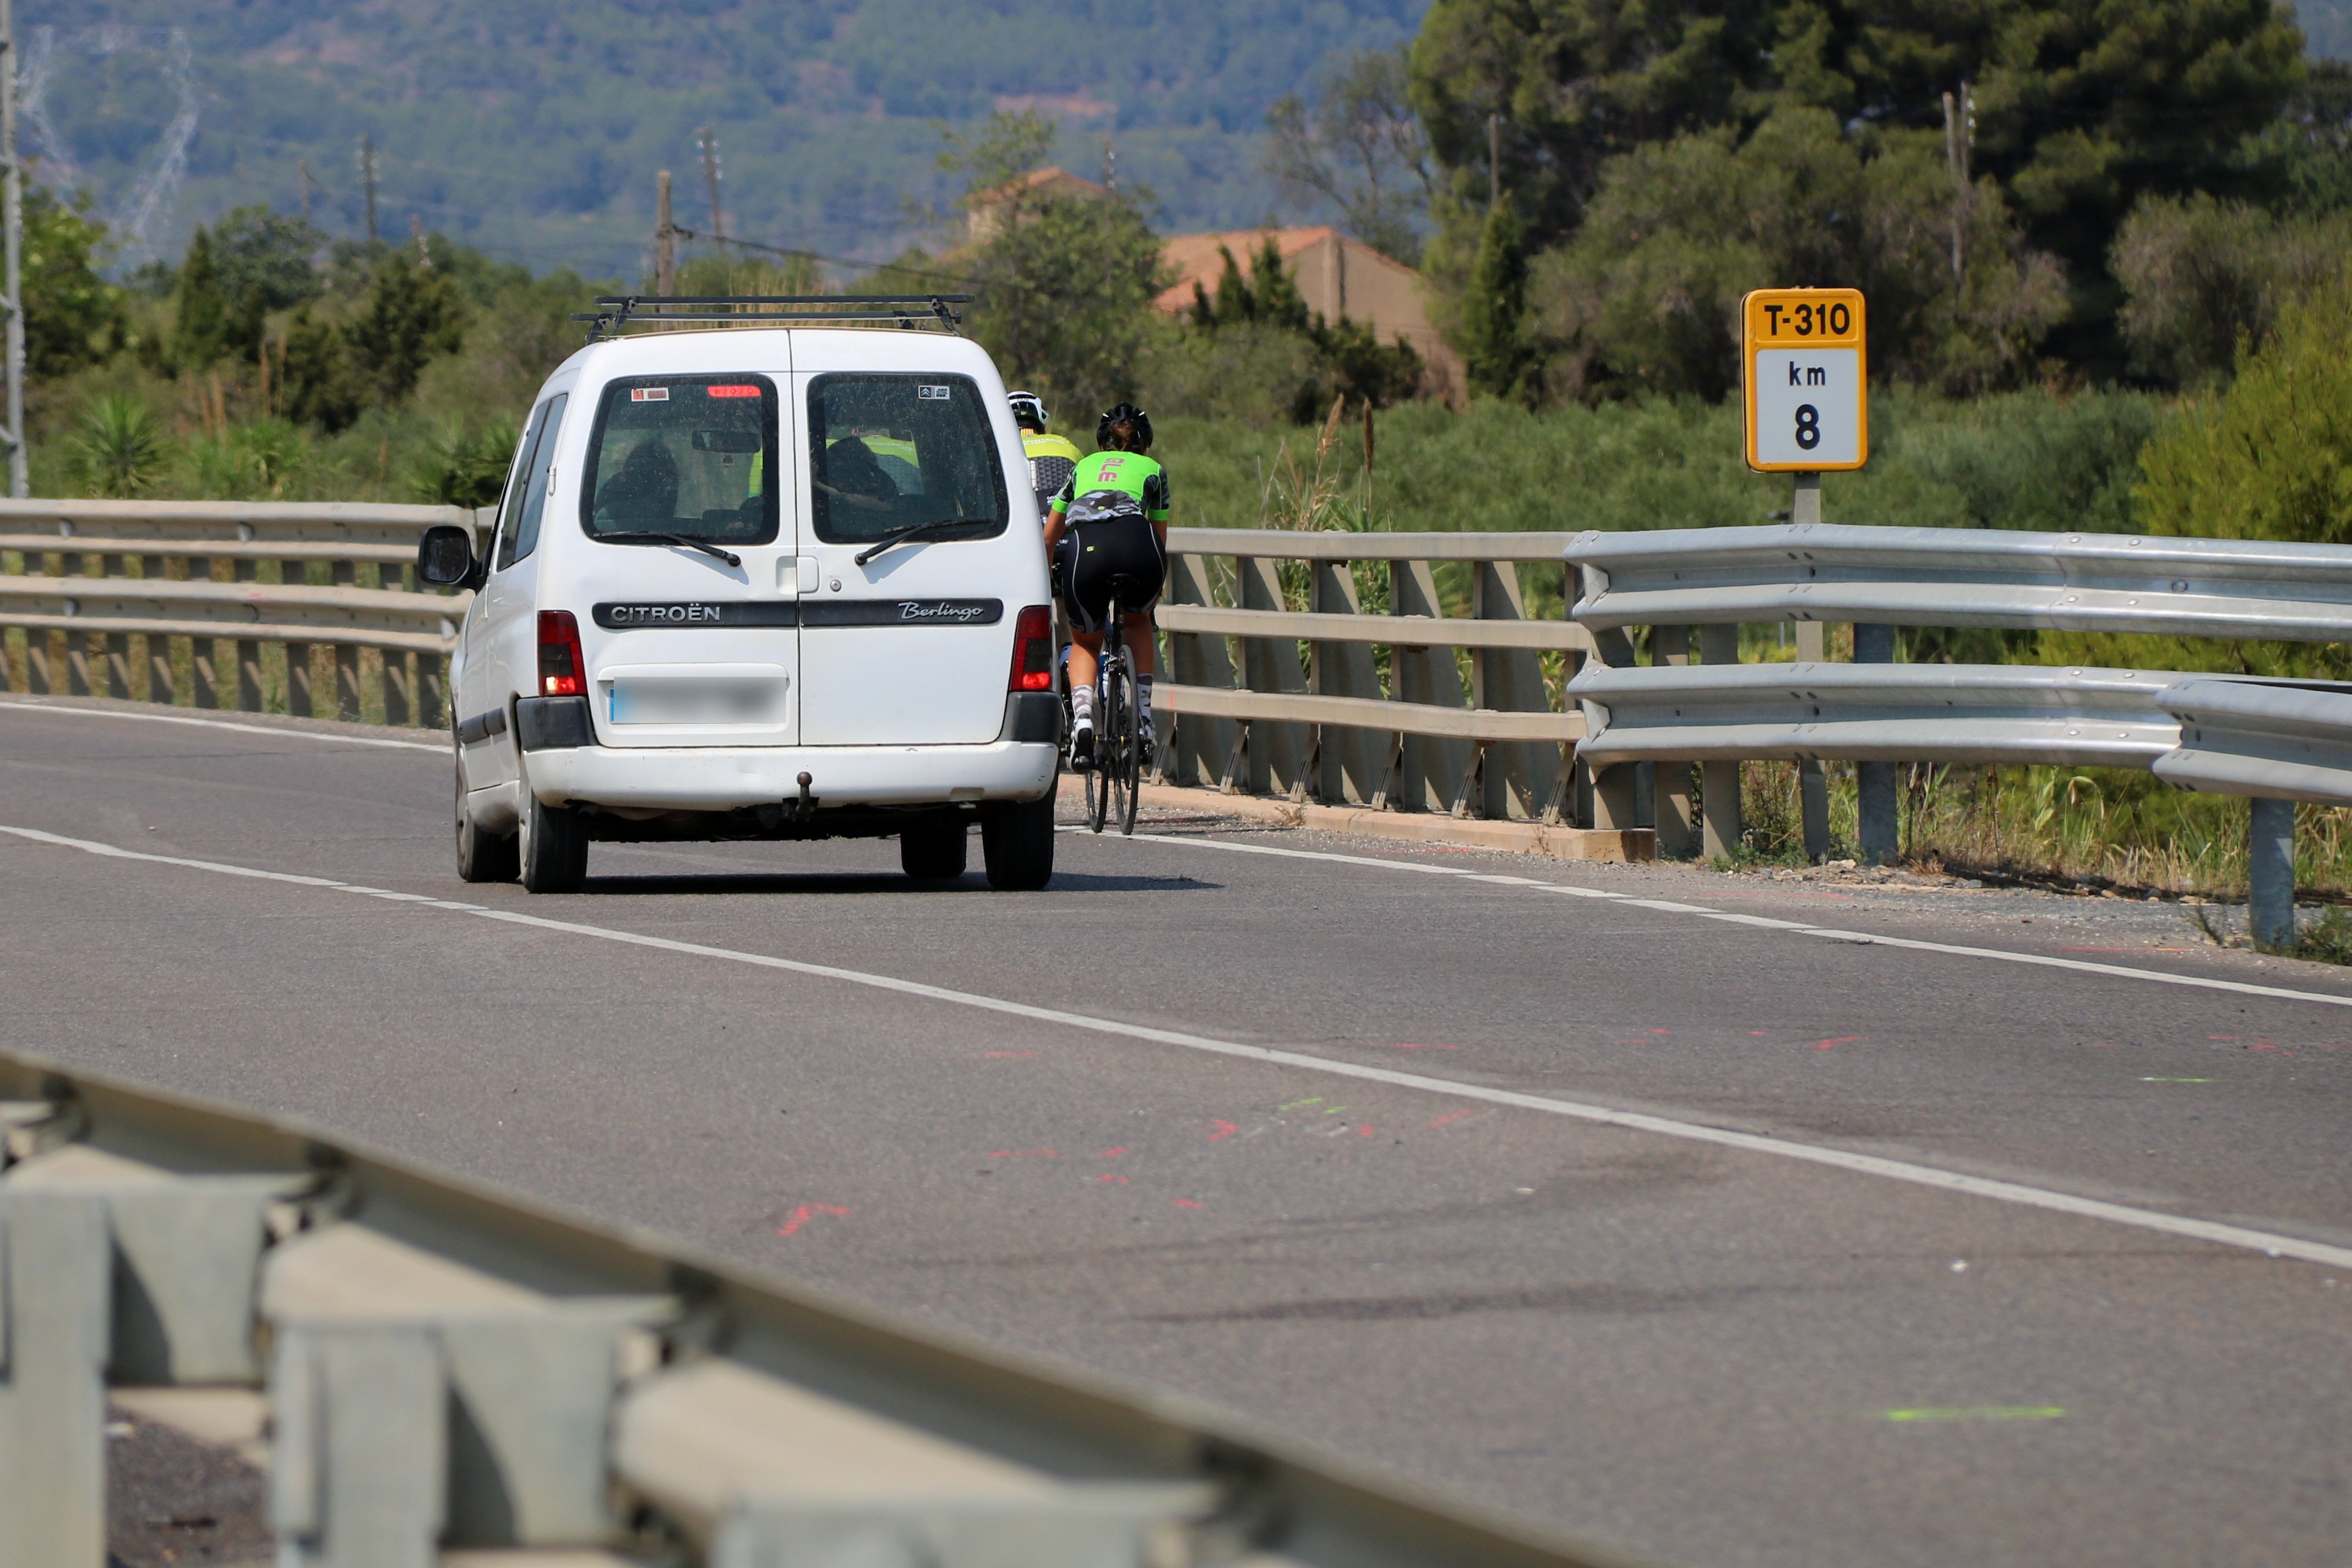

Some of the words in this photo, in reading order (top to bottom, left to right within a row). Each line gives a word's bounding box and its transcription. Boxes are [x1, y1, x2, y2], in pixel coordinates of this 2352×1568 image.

[1764, 303, 1850, 335] T-310
[1789, 361, 1826, 386] km
[1795, 404, 1820, 450] 8
[611, 602, 721, 623] CITROËN
[898, 601, 984, 621] Berlingo
